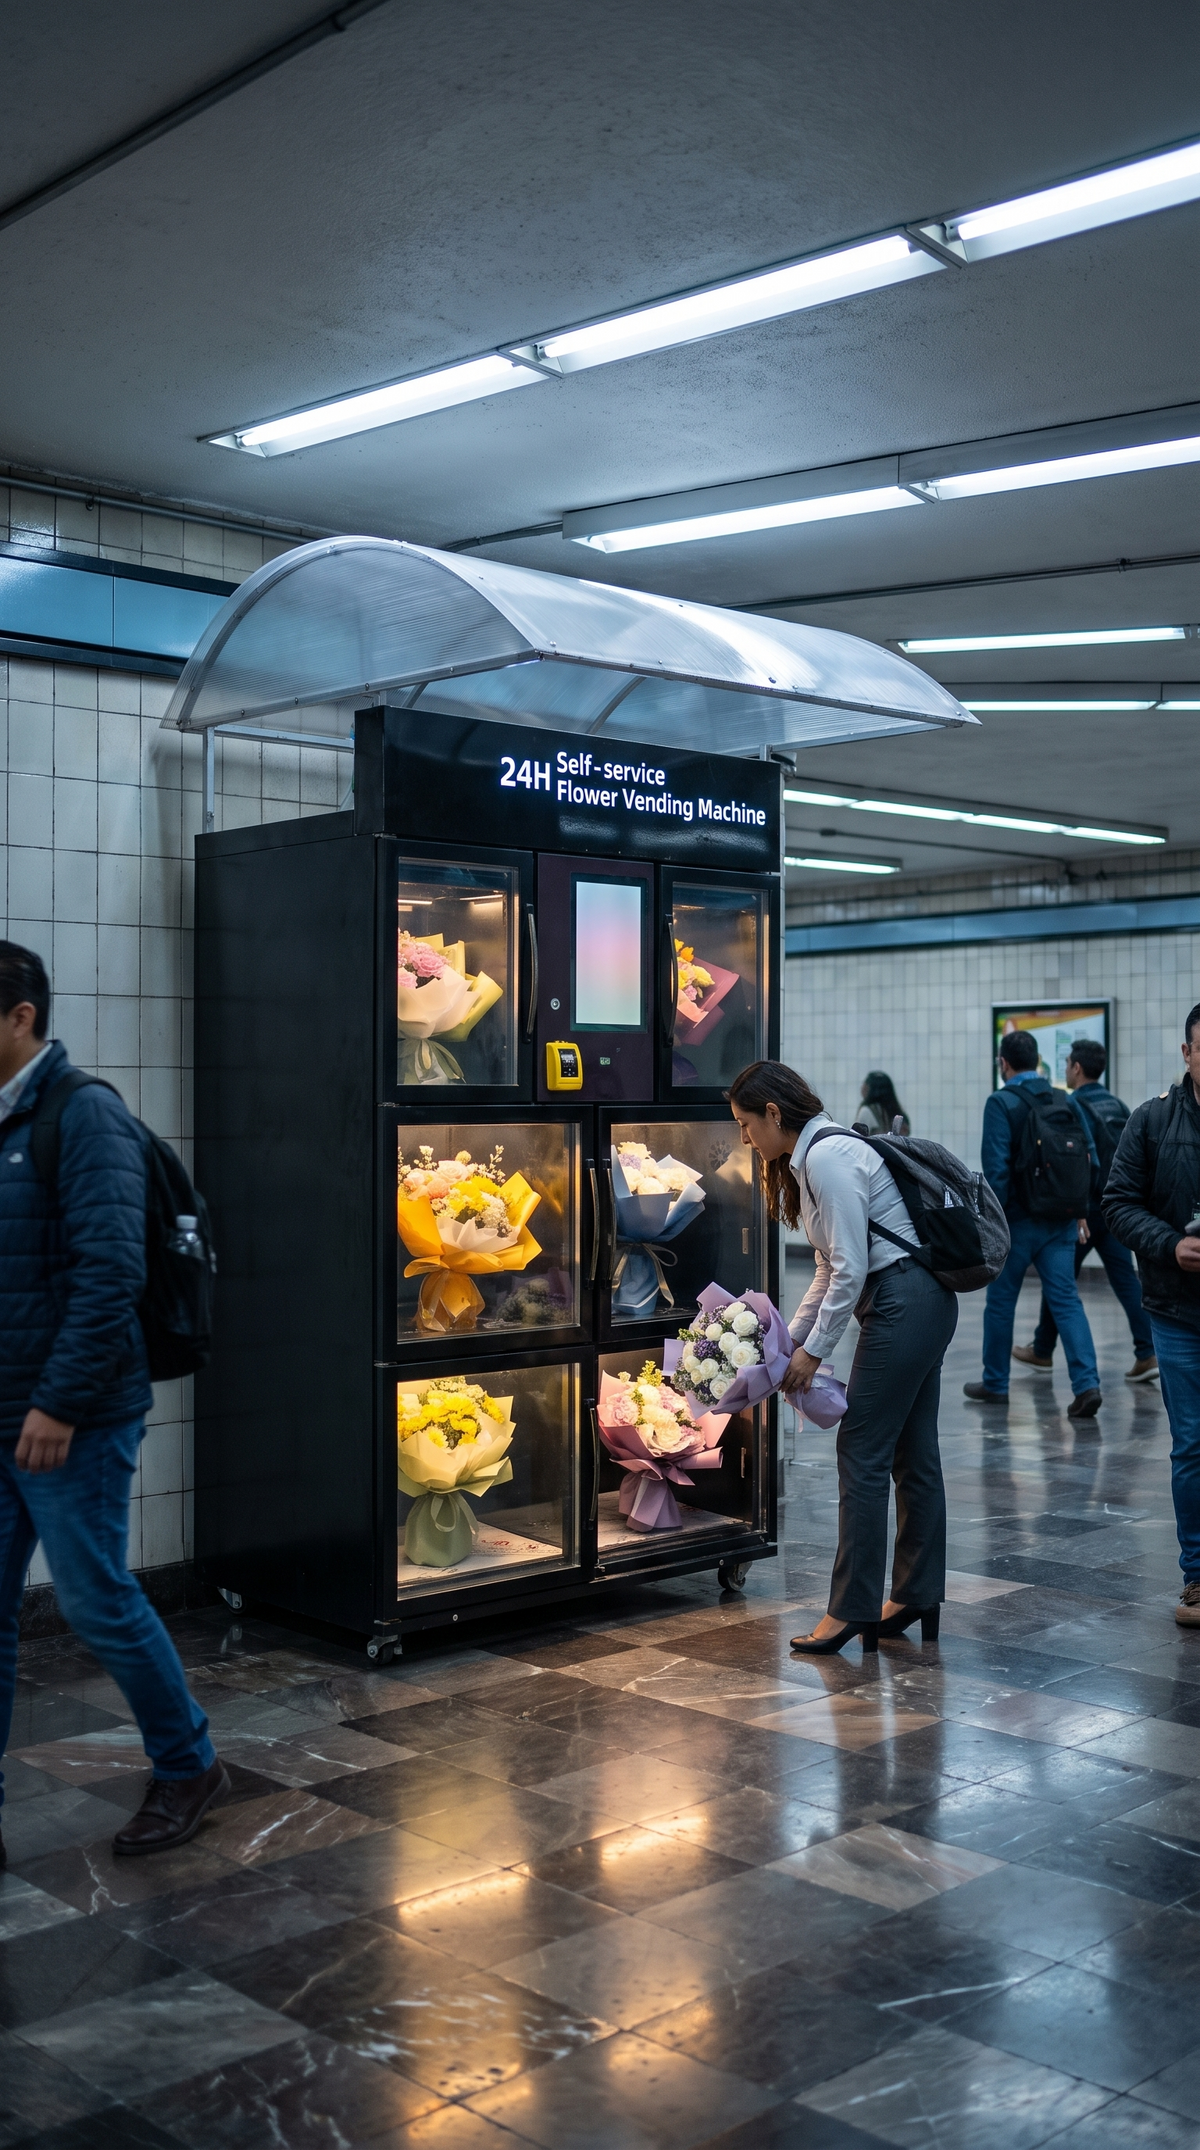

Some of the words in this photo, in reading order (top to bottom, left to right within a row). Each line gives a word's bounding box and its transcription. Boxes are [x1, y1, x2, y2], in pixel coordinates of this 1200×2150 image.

[500, 756, 551, 791] 24H
[556, 751, 666, 786] Self-service
[557, 779, 618, 808] Flower
[622, 788, 693, 822] Vending
[698, 798, 766, 826] Machine
